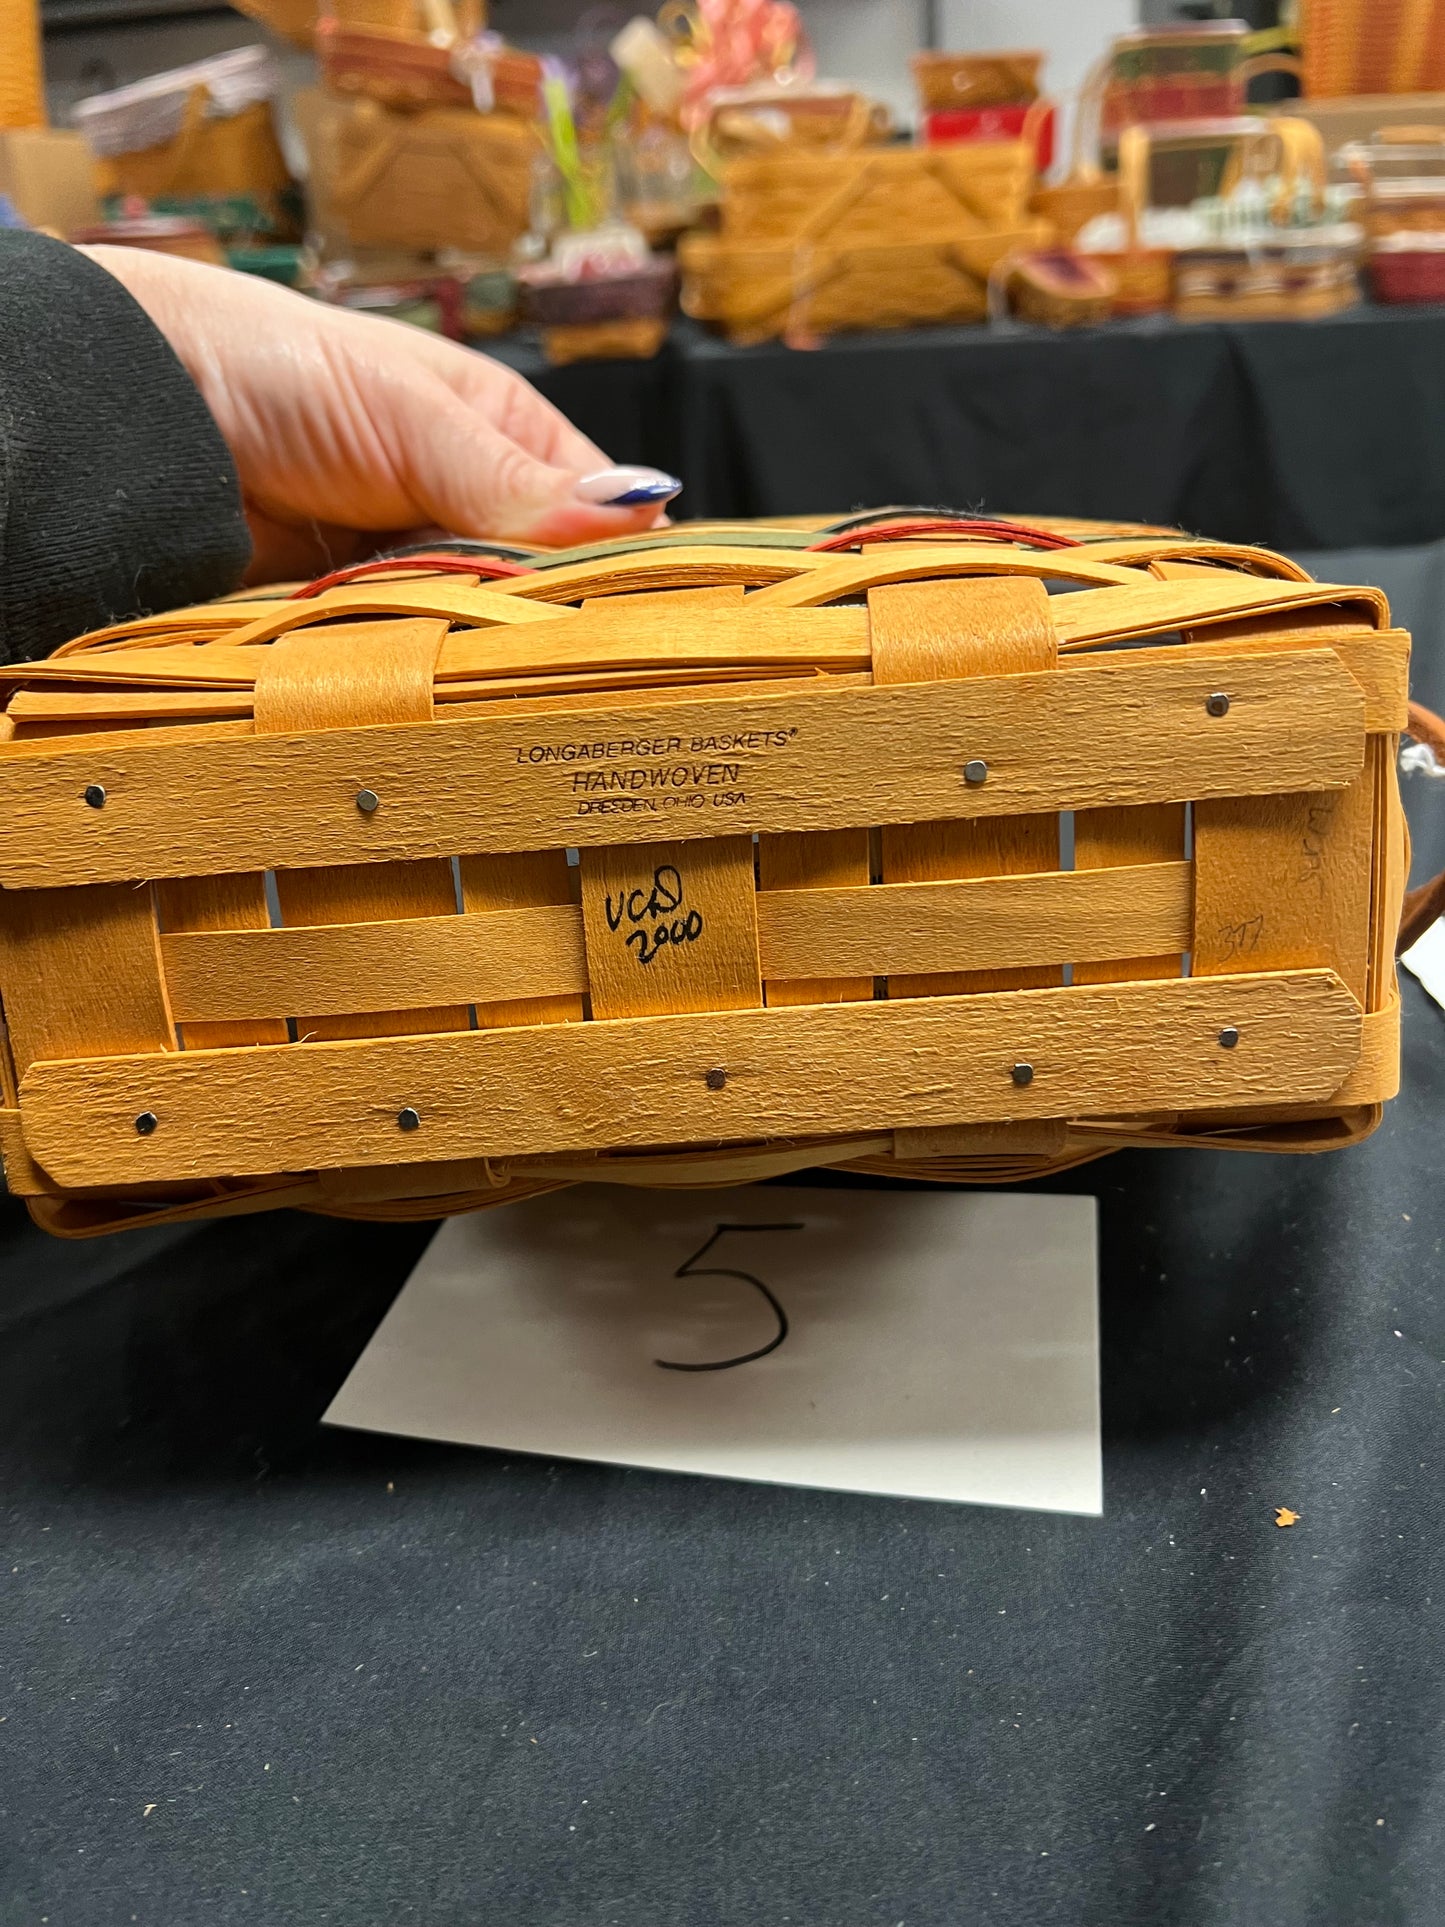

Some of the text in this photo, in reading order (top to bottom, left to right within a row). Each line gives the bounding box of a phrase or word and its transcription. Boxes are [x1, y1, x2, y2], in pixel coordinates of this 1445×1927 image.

[516, 738, 681, 763] LONGABERGER
[572, 764, 740, 792] HANDWOVEN
[662, 794, 706, 809] OHIO
[713, 792, 748, 807] USA
[625, 910, 703, 964] 2000
[654, 1223, 806, 1372] 5
